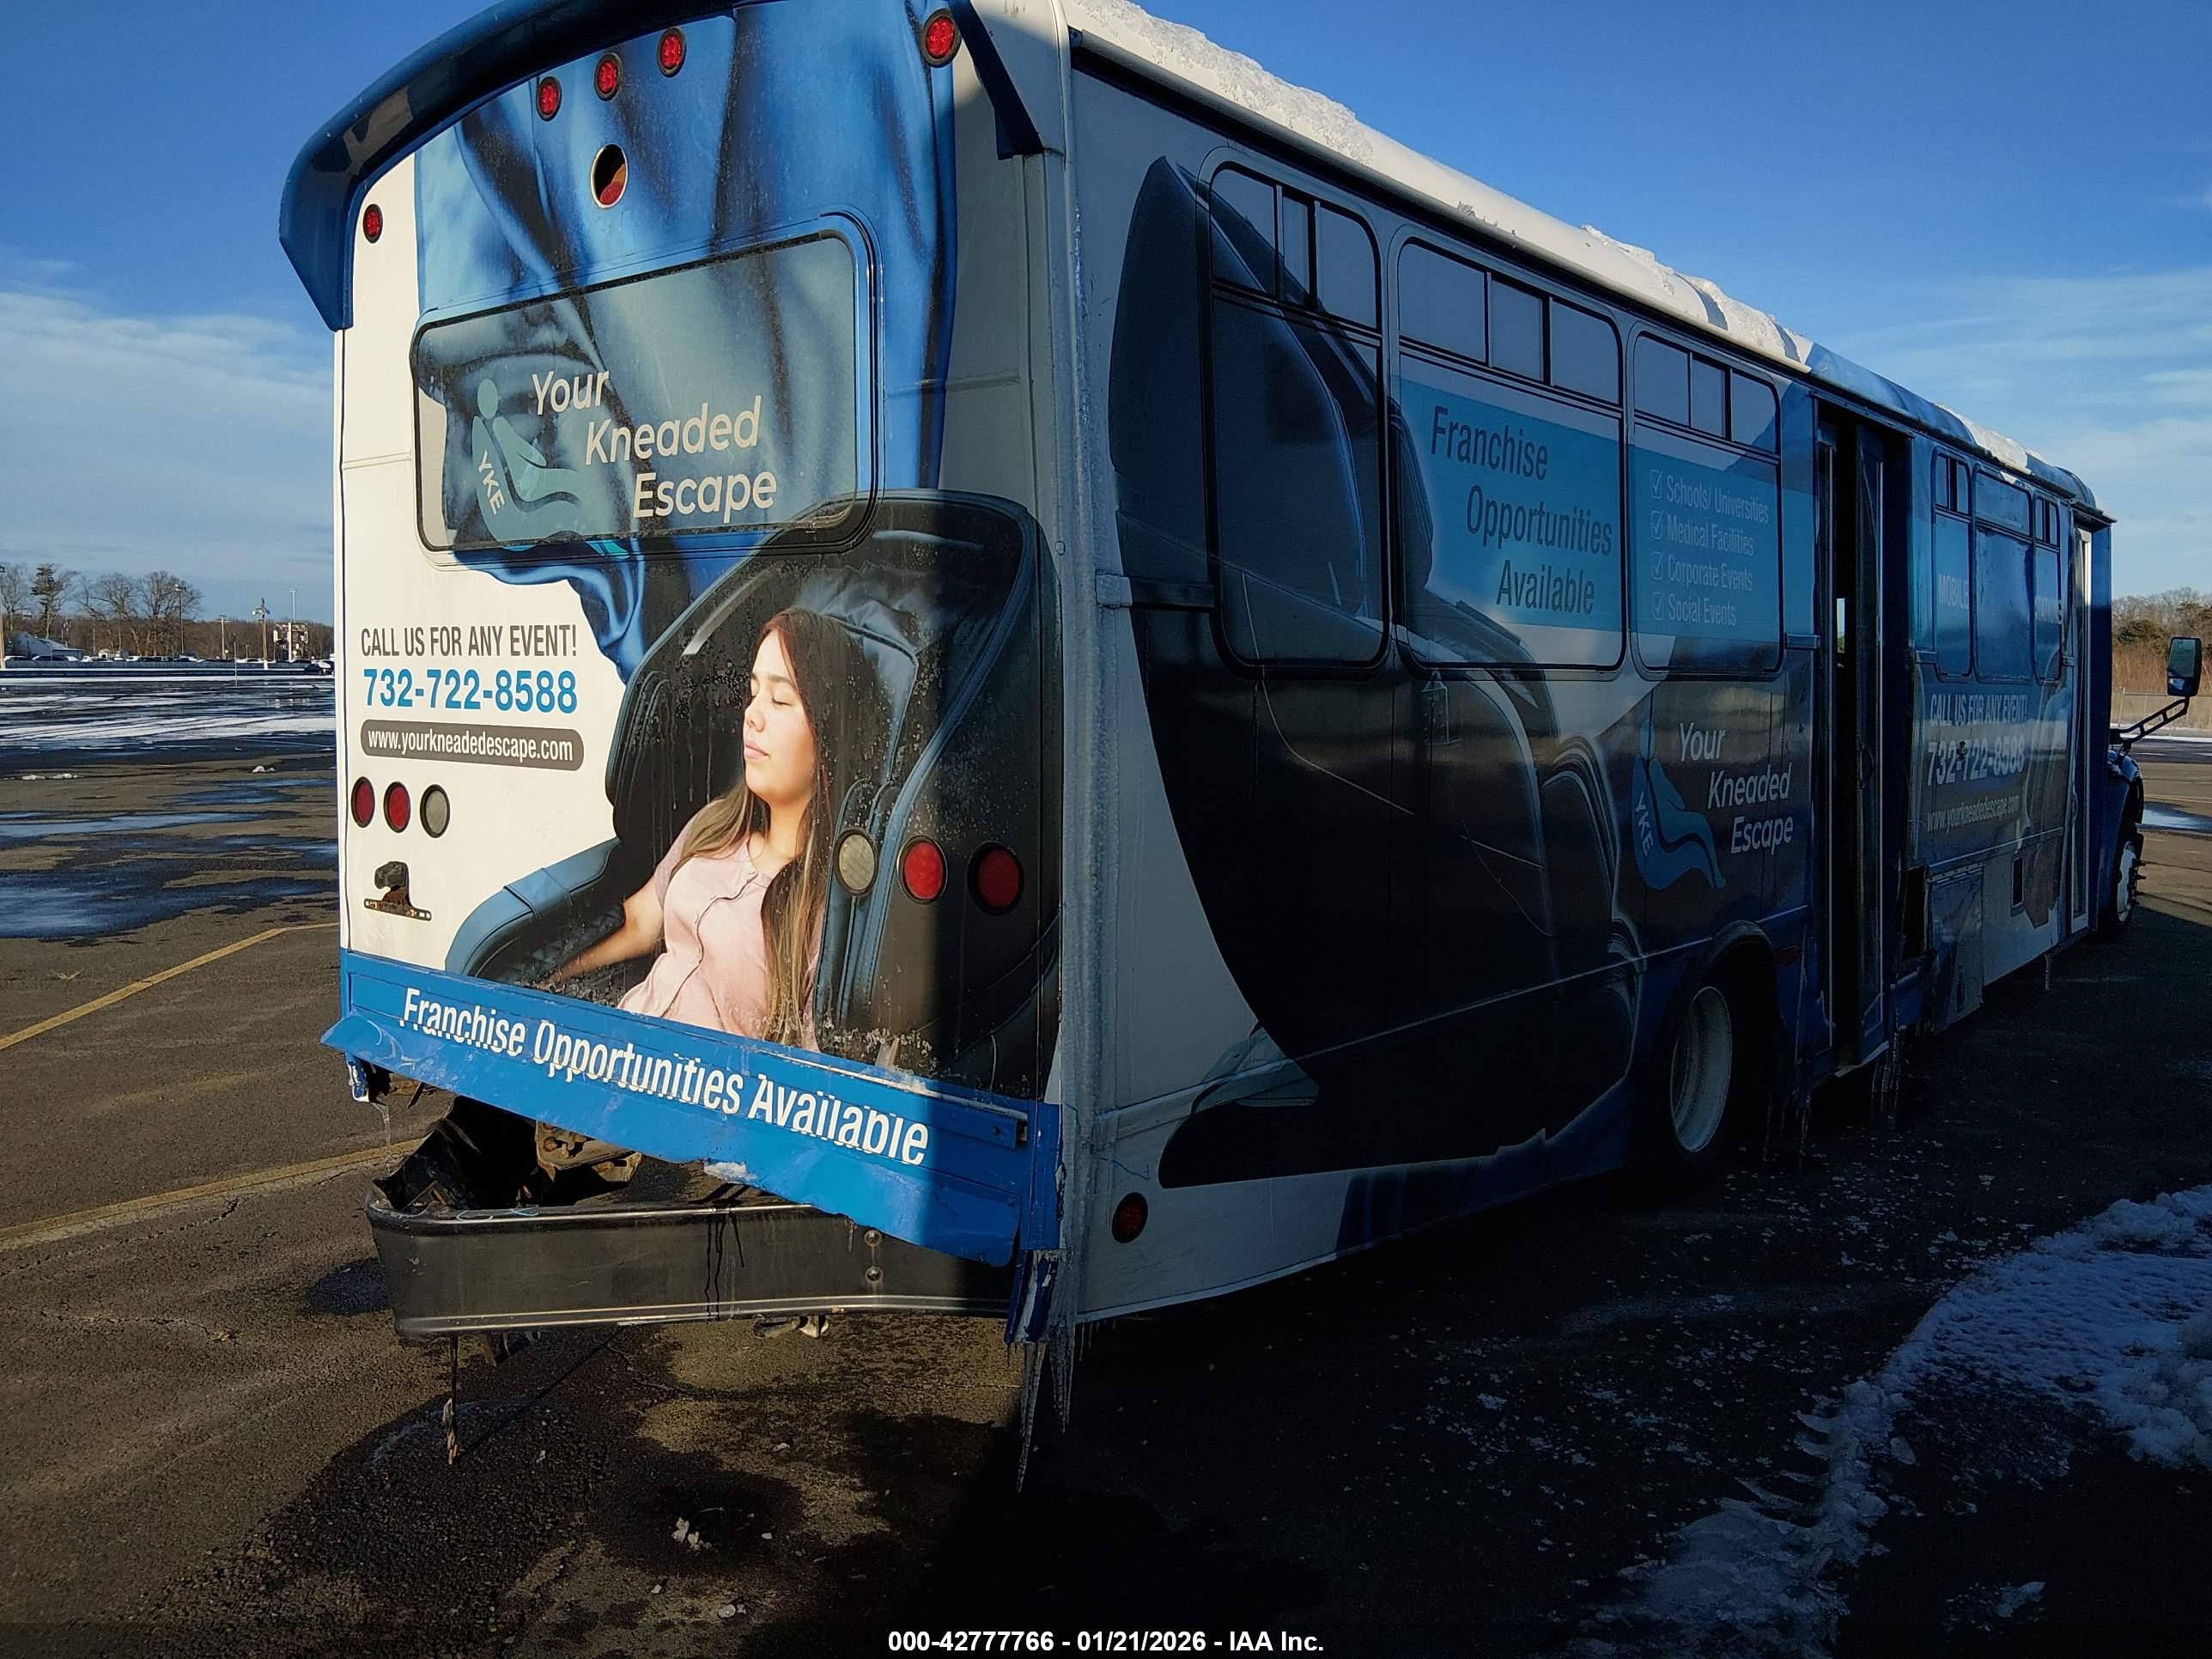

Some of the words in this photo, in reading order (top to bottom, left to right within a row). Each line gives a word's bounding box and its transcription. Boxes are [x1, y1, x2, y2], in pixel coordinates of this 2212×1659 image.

[532, 370, 610, 416] Your
[585, 394, 763, 465] Kneaded
[1431, 404, 1548, 480] Franchise
[477, 449, 506, 515] YKE
[632, 470, 778, 523] Escape
[1667, 475, 1711, 510] Schools/
[1714, 487, 1769, 524] Universities
[1467, 484, 1613, 556] Opportunities
[1667, 514, 1709, 549] Medical
[1711, 523, 1753, 556] Facilities
[1496, 559, 1595, 615] Available
[1668, 554, 1718, 589] Corporate
[1721, 563, 1753, 591] Events
[1668, 592, 1700, 623] Social
[1704, 598, 1735, 625] Events
[361, 628, 399, 657] CALL
[404, 626, 425, 657] US
[430, 625, 462, 656] FOR
[468, 625, 503, 657] ANY
[509, 624, 577, 657] EVENT!
[363, 668, 578, 714] 732-722-8588
[1930, 694, 1952, 726] CALL
[1954, 694, 1966, 726] US
[1968, 694, 1984, 725] FOR
[1984, 694, 2002, 724] ANY
[368, 728, 574, 763] www.yourkneadedescape.com
[1680, 722, 1726, 762] Your
[1928, 734, 2025, 786] 732-722-8588
[1707, 762, 1793, 810] Kneaded
[1635, 791, 1654, 857] YKE
[1730, 816, 1794, 855] Escape
[398, 988, 526, 1057] Franchise
[532, 1019, 744, 1115] Opportunities
[748, 1073, 929, 1166] Available
